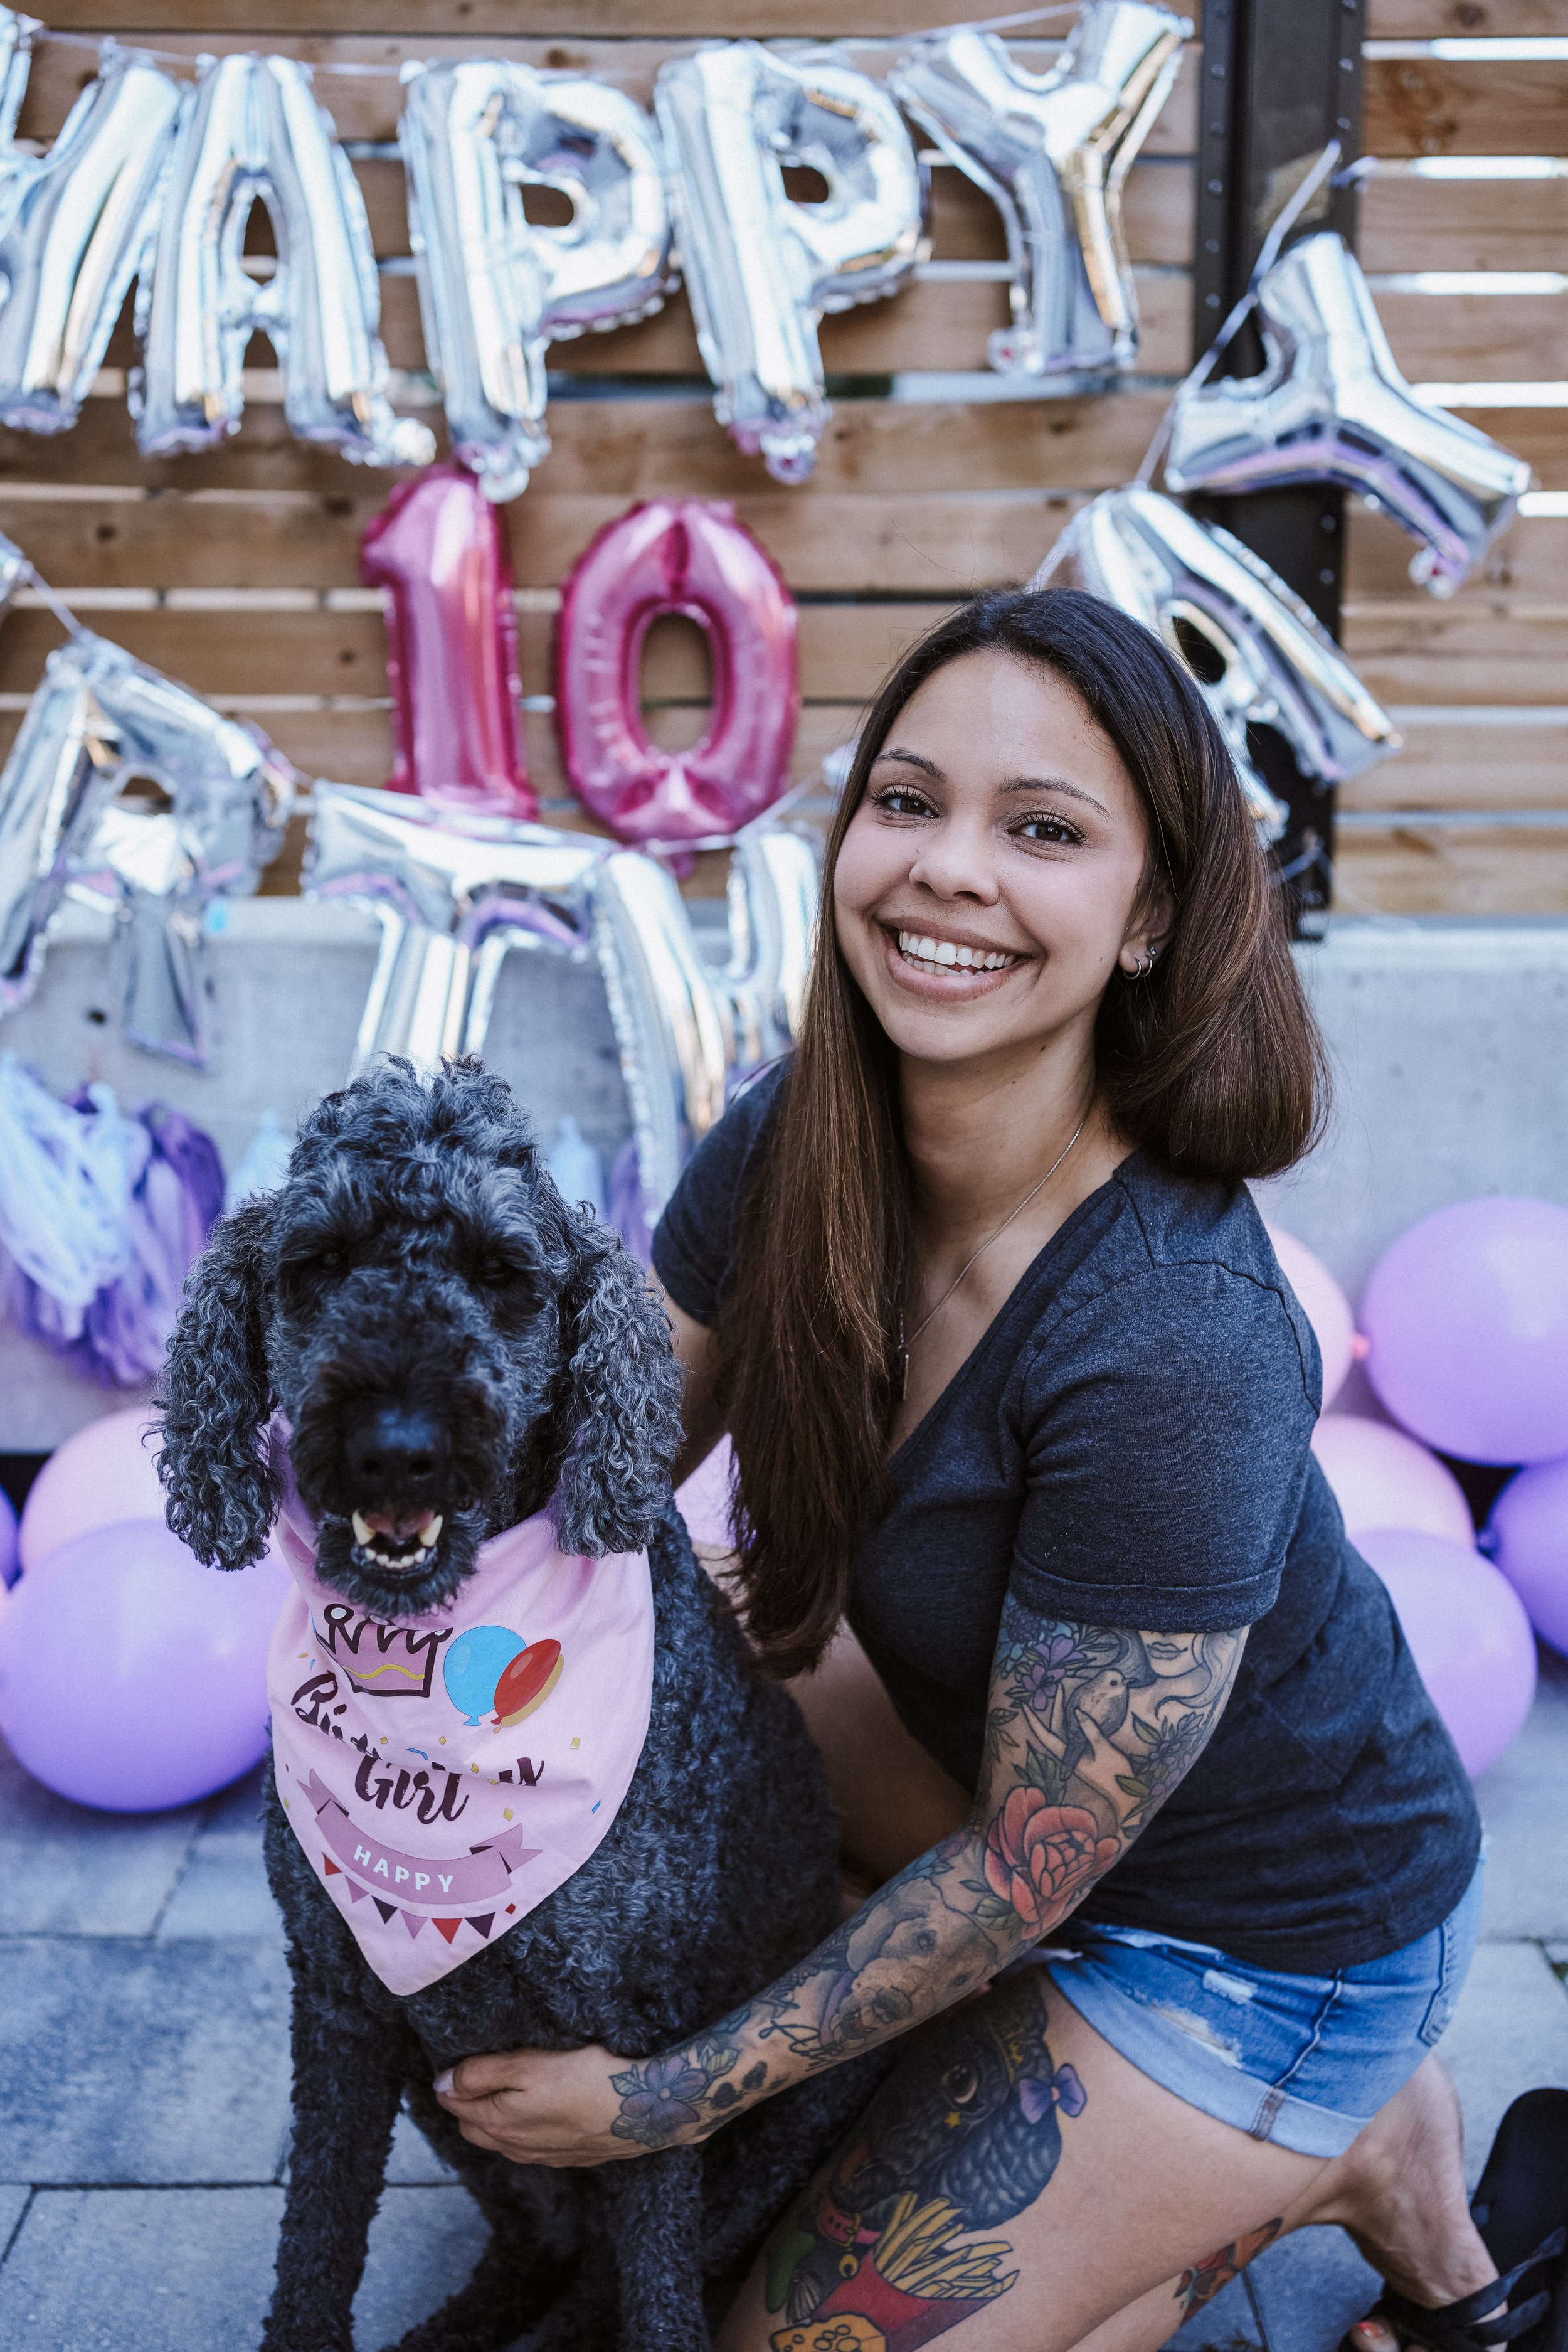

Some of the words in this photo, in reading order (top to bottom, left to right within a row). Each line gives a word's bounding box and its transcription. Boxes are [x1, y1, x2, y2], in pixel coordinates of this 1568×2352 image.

[0, 0, 1194, 496] HAPPY
[361, 464, 799, 844] 10
[353, 1844, 453, 1893] HAPPY
[354, 1754, 469, 1824] Girl
